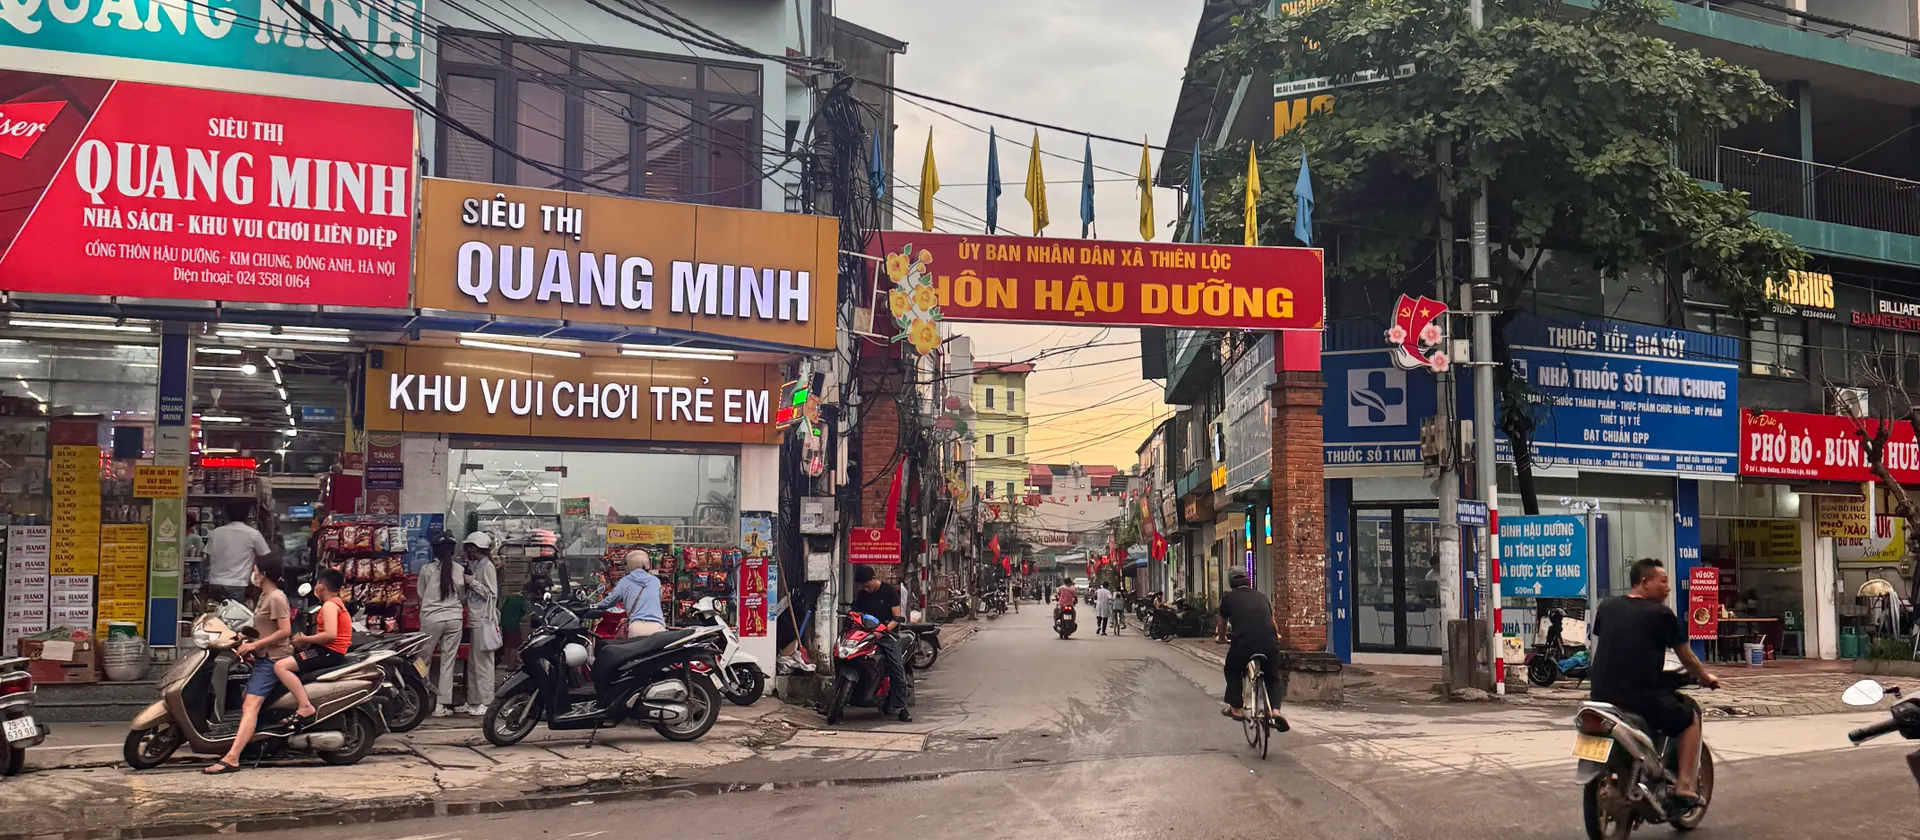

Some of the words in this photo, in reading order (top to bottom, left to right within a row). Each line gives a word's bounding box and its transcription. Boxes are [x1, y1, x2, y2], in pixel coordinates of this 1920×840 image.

[209, 116, 248, 141] SIÊU
[252, 122, 284, 145] THỊ
[75, 138, 254, 205] QUANG
[269, 154, 408, 218] MINH
[462, 191, 526, 229] SIÊU
[540, 204, 583, 241] THỊ
[83, 206, 123, 229] NHÀ
[127, 208, 174, 232] SÁCH
[188, 214, 228, 236] KHU
[232, 218, 263, 238] VUI
[267, 220, 310, 242] CHƠI
[314, 222, 353, 245] LIÊN
[356, 226, 398, 250] DIỆP
[85, 239, 116, 257] CỔNG
[118, 243, 150, 259] THÔN
[153, 245, 179, 263] HẬU
[181, 247, 220, 264] DƯỠNG
[230, 251, 250, 266] KIM
[252, 252, 293, 270] CHUNG,
[296, 254, 326, 271] ĐÔNG
[328, 258, 355, 274] ANH,
[358, 258, 375, 274] HÀ
[377, 260, 396, 278] NỘI
[958, 236, 984, 261] ỦY
[985, 244, 1020, 262] BAN
[1026, 243, 1076, 266] NHÂN
[1079, 245, 1116, 267] DÂN
[1120, 246, 1145, 268] XÃ
[1149, 248, 1196, 270] THIÊN
[1201, 249, 1232, 272] LỘC
[173, 266, 198, 284] Điện
[201, 267, 233, 286] thoại:
[236, 270, 256, 286] 024
[258, 272, 283, 288] 3581
[285, 273, 310, 289] 0164
[456, 240, 654, 312] QUANG
[669, 259, 811, 323] MINH
[932, 270, 1018, 310] HÔN
[1035, 274, 1125, 318] HẬU
[1141, 278, 1295, 320] DƯỠNG
[1852, 311, 1891, 327] GAMING
[1548, 321, 1597, 350] THUỐC
[1603, 325, 1628, 353] TỐT
[1635, 332, 1660, 357] GIÁ
[1661, 330, 1686, 358] TỐT
[1538, 362, 1570, 388] NHÀ
[1574, 361, 1619, 391] THUỐC
[1623, 364, 1644, 393] SỐ
[1653, 377, 1680, 396] KIM
[1681, 378, 1727, 400] CHUNG
[161, 404, 184, 412] QUANG
[389, 373, 468, 413] KHU
[480, 378, 544, 417] VUI
[552, 381, 638, 420] CHƠI
[649, 376, 714, 423] TRẺ
[723, 388, 770, 424] EM
[1632, 431, 1650, 445] GPP
[1750, 422, 1787, 463] PHỞ
[1789, 427, 1813, 465] BÒ
[1824, 431, 1859, 468] BÚN
[1327, 445, 1363, 463] THUỐC
[1367, 445, 1383, 462] SỐ
[1393, 448, 1416, 462] KIM
[1501, 522, 1522, 538] ĐÌNH
[1523, 521, 1541, 540] HẬU
[1543, 520, 1574, 536] DƯỠNG
[1682, 516, 1693, 527] AN
[1820, 519, 1844, 528] PHỞ
[1847, 523, 1867, 536] XÀO
[1504, 545, 1513, 558] DI
[1515, 542, 1535, 558] TÍCH
[1536, 544, 1557, 560] LỊCH
[1558, 538, 1573, 558] SỬ
[1679, 545, 1699, 559] TOÀN
[1510, 563, 1534, 581] ĐƯỢC
[1535, 559, 1553, 578] XẾP
[1555, 564, 1581, 581] HẠNG
[1514, 586, 1534, 595] 500m
[1502, 619, 1521, 634] NHÀ
